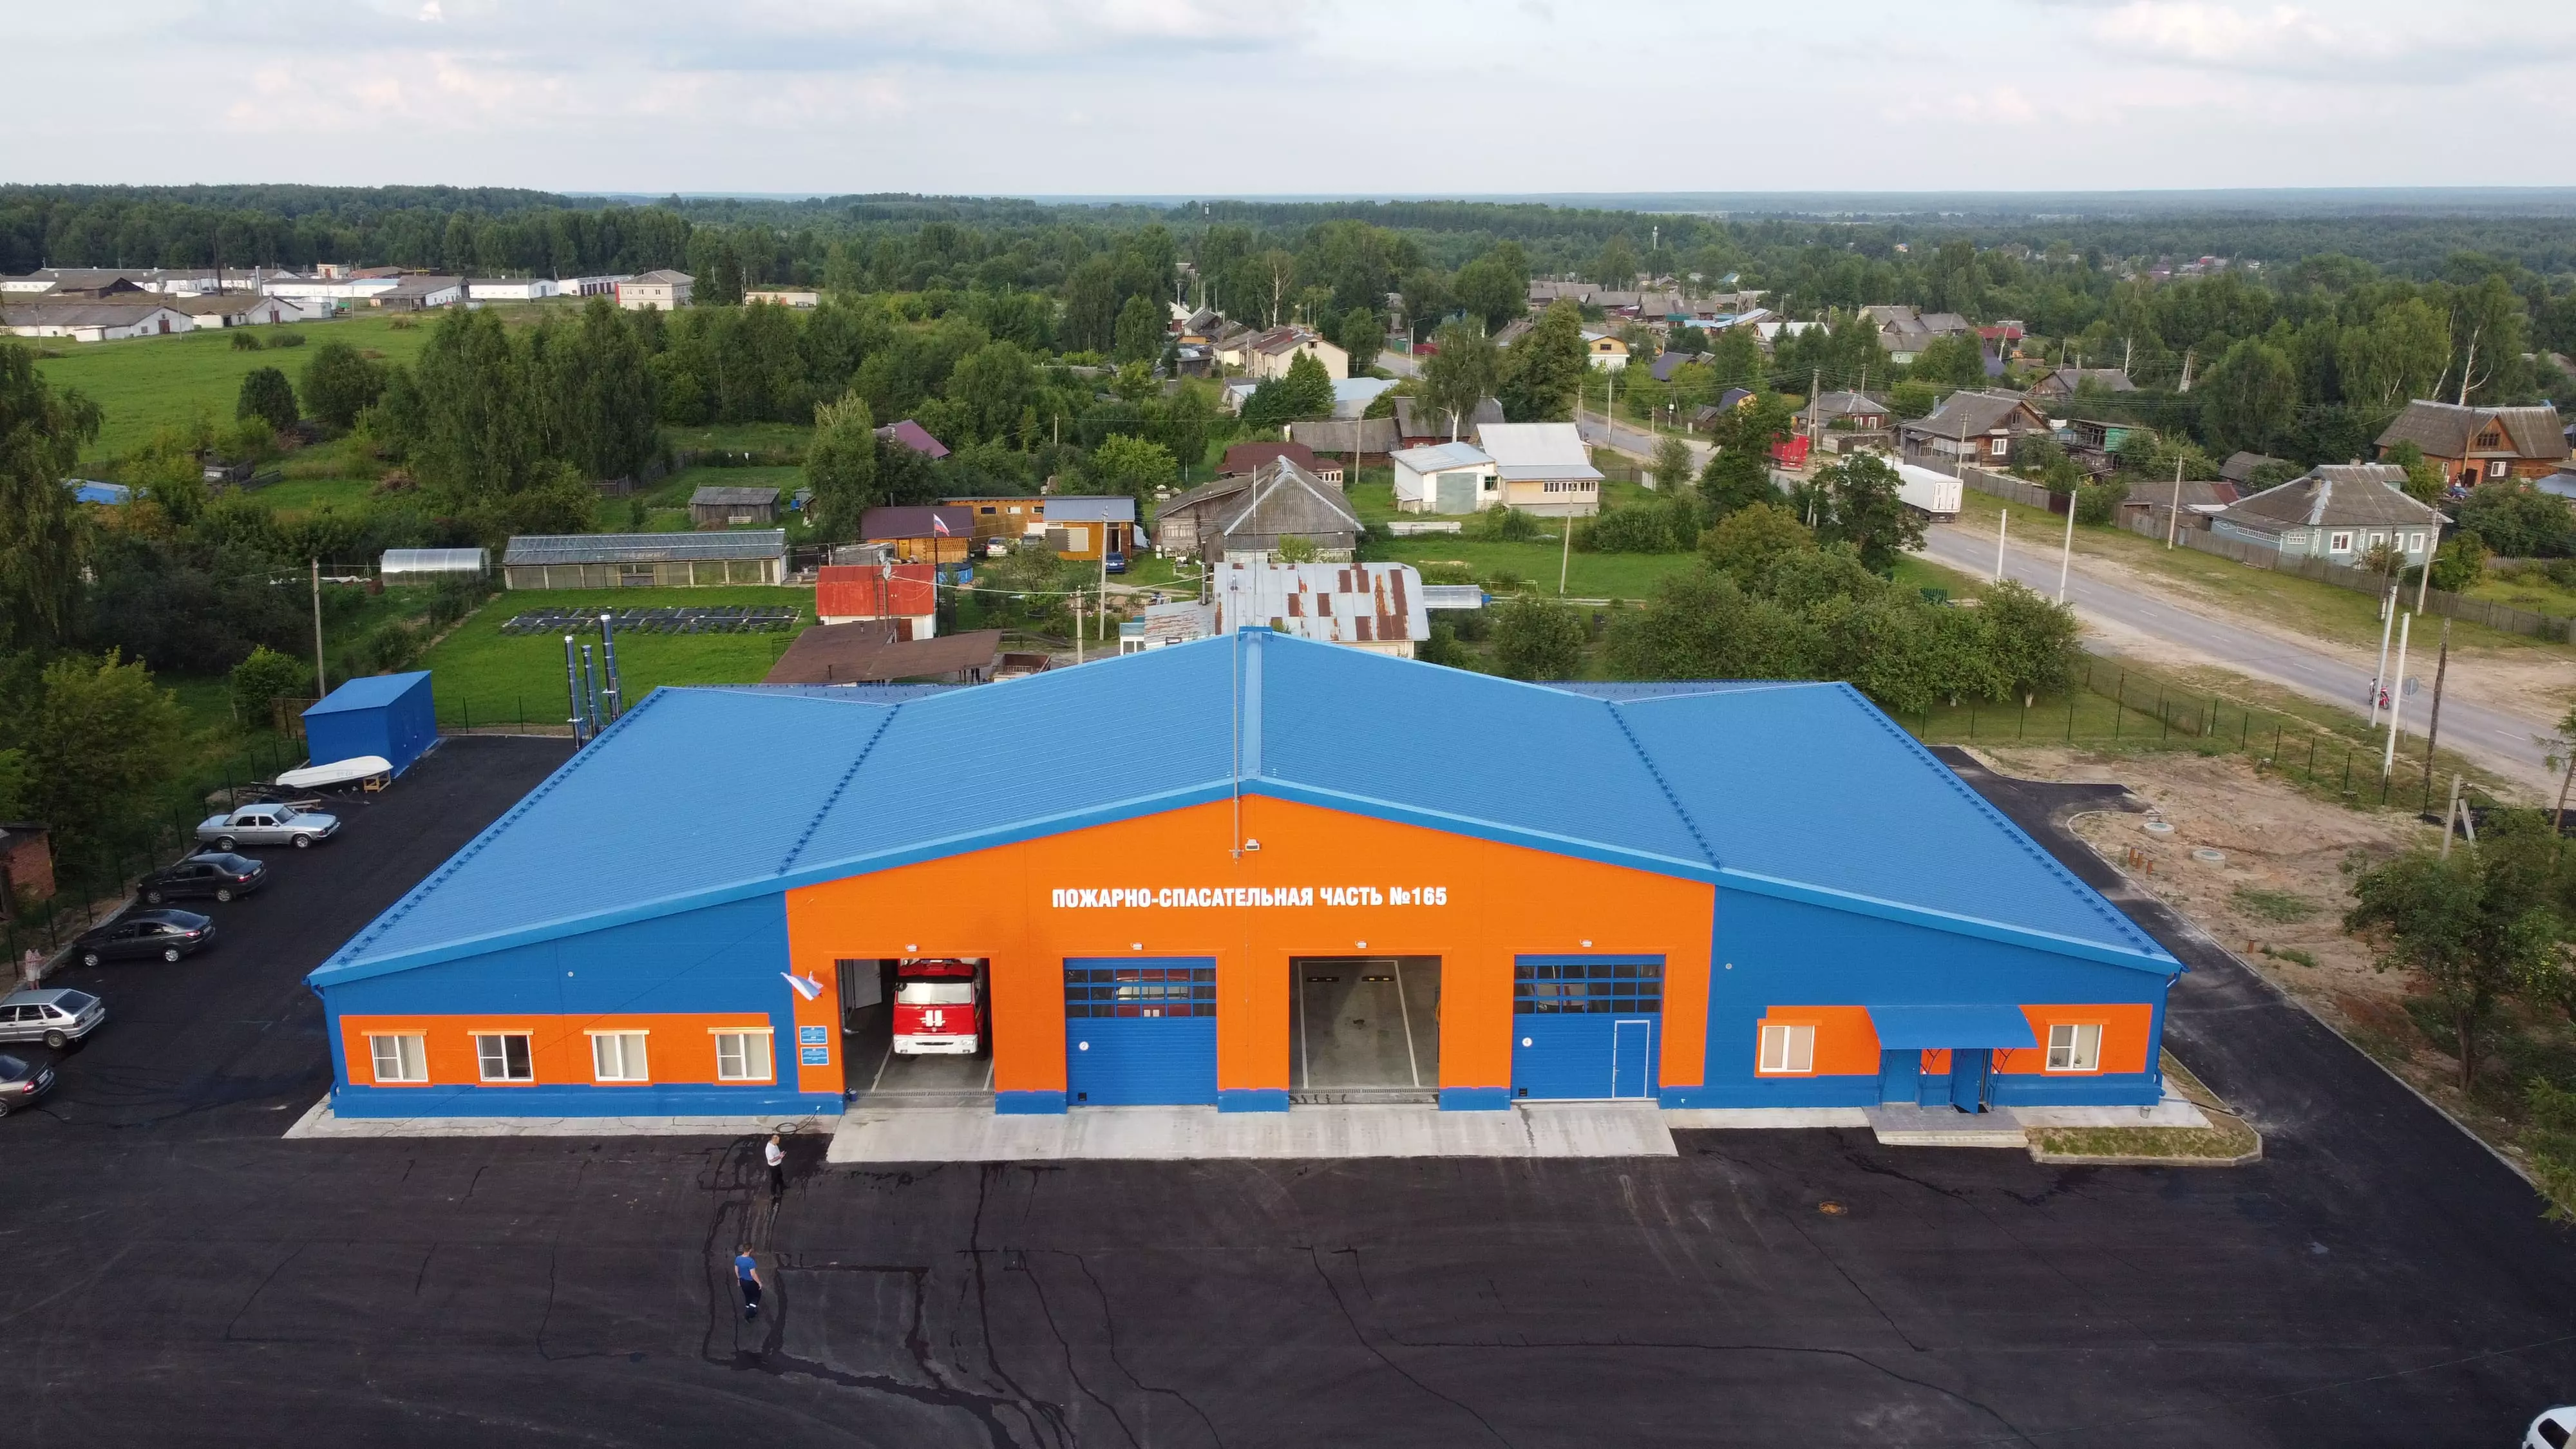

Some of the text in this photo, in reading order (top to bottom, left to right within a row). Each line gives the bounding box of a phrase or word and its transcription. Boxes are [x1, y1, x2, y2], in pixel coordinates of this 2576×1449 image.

[1052, 886, 1447, 907] ПОЖАРНО-СПАСАТЕЛЬНАЯ ЧАСТЬ №165
